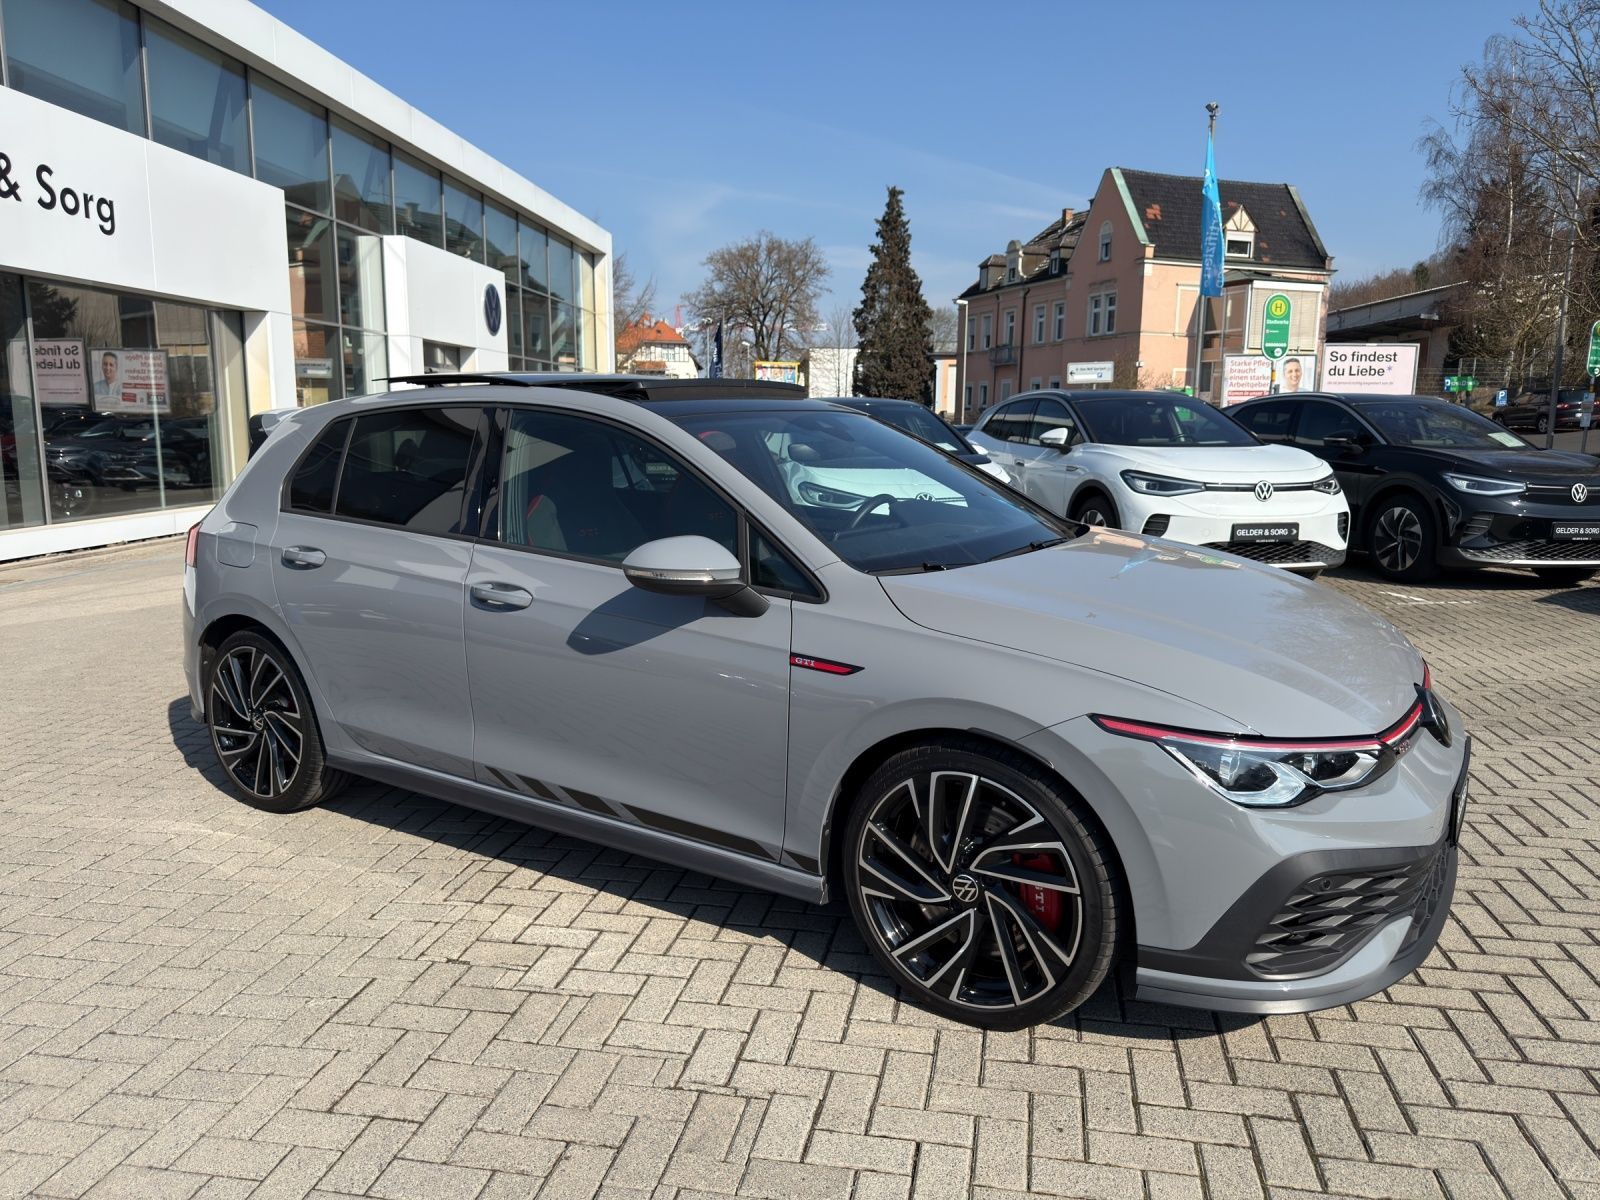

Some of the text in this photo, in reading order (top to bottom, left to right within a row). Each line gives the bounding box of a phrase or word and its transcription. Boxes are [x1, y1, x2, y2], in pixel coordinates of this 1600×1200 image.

[0, 152, 115, 236] & Sorg
[1274, 302, 1283, 313] H
[1329, 351, 1398, 363] So findest
[1253, 360, 1271, 369] Pfleg
[1328, 365, 1345, 377] du
[1236, 529, 1263, 537] GELDER
[1270, 528, 1289, 536] SORG
[1585, 527, 1600, 535] SORG
[795, 656, 816, 667] GTI
